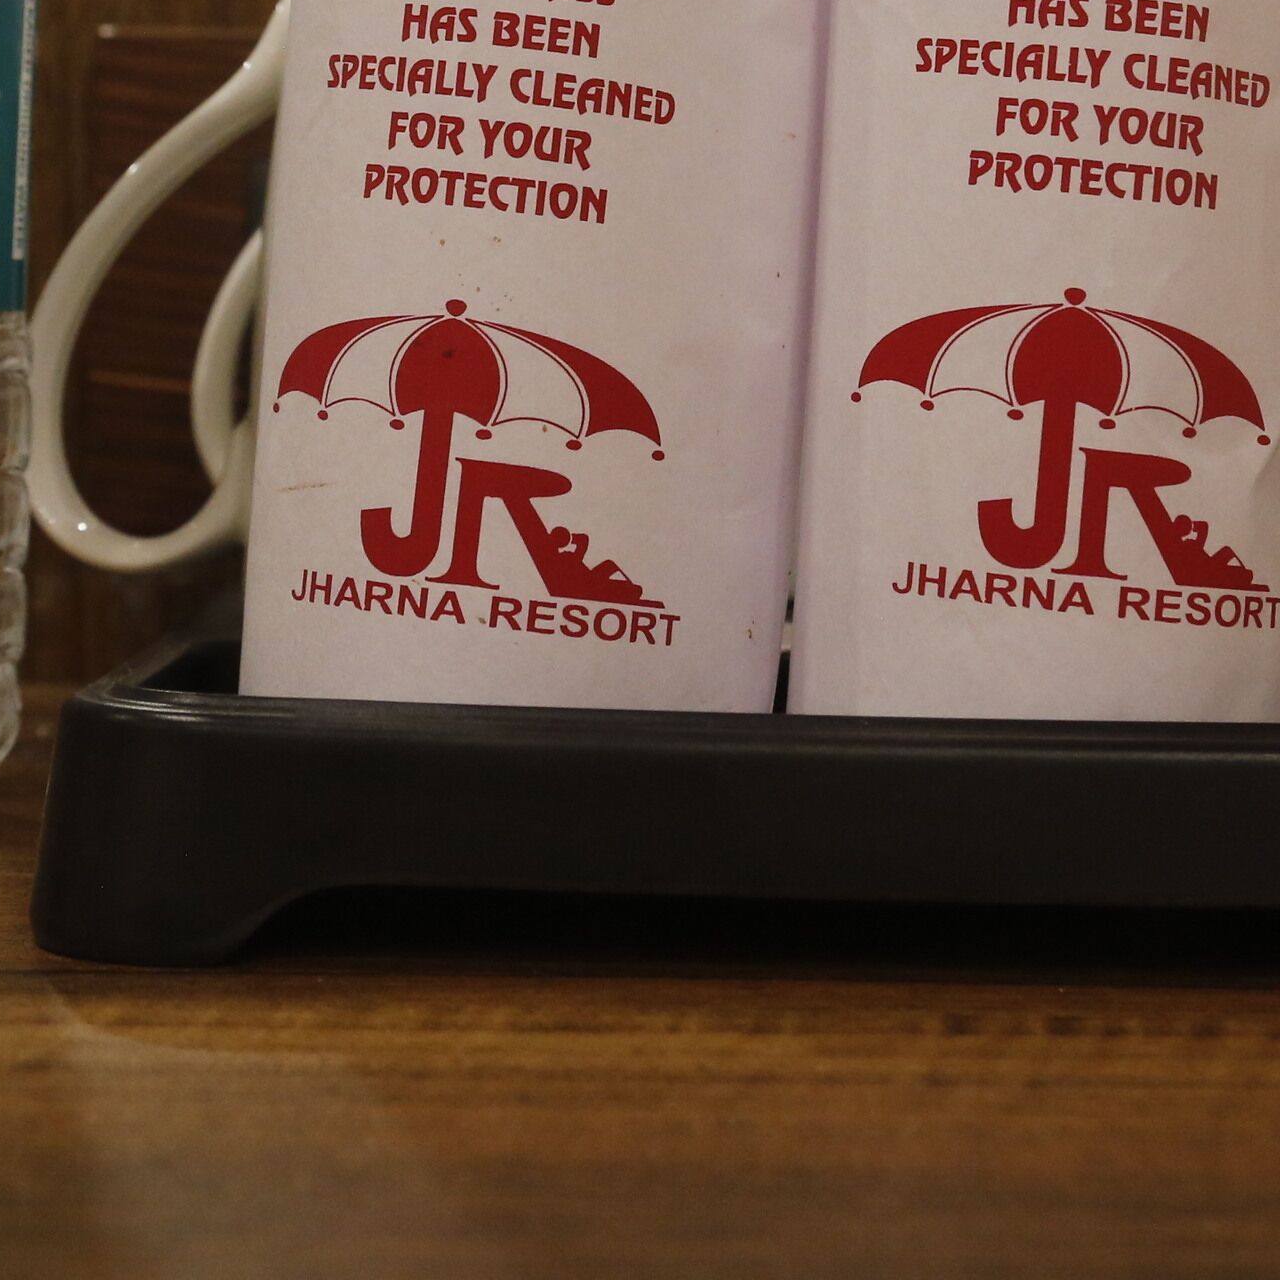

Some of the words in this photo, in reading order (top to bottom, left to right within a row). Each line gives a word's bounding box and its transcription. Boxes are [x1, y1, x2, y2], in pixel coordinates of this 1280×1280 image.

[401, 3, 478, 44] HAS
[492, 11, 600, 58] BEEN
[327, 54, 498, 103] SPECIALLY
[509, 68, 675, 125] CLEANED
[915, 38, 1111, 89] SPECIALLY
[1123, 54, 1270, 108] CLEANED
[388, 111, 465, 156] FOR
[478, 118, 592, 170] YOUR
[996, 97, 1079, 142] FOR
[1093, 105, 1204, 157] YOUR
[363, 163, 608, 224] PROTECTION
[968, 150, 1218, 210] PROTECTION
[290, 567, 466, 624] JHARNA
[487, 596, 681, 646] RESORT
[891, 560, 1094, 616] JHARNA
